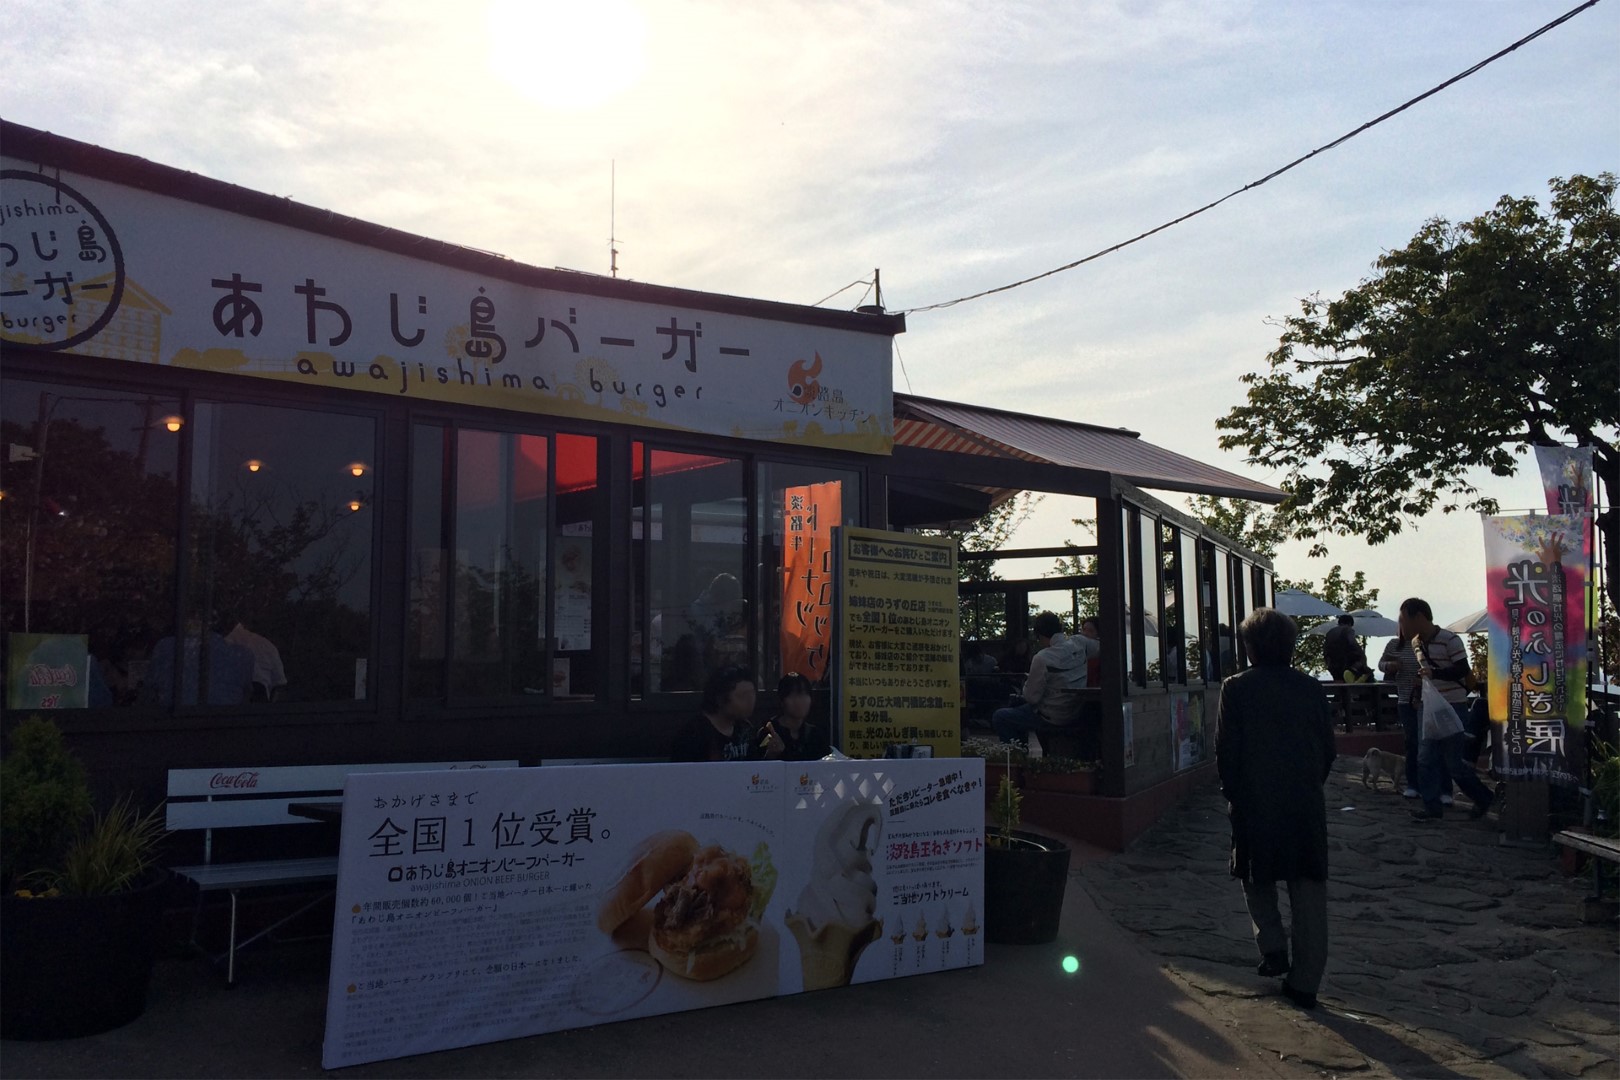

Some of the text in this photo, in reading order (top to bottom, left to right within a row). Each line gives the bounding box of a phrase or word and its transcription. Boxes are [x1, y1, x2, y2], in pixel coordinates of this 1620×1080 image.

[211, 273, 750, 373] あわじ島バーガー
[297, 357, 703, 407] awajishima burger
[773, 398, 872, 423] オニオンキッチン
[209, 772, 260, 789] Coca-Cola
[374, 791, 479, 809] おかげさまで
[367, 807, 611, 858] 全国1位受賞。
[886, 837, 983, 861] 淡路島玉ねぎソフト
[405, 852, 585, 880] あわじ島オニオンビーフバーガー
[410, 870, 550, 893] awajishima ONION BEEF BURGER
